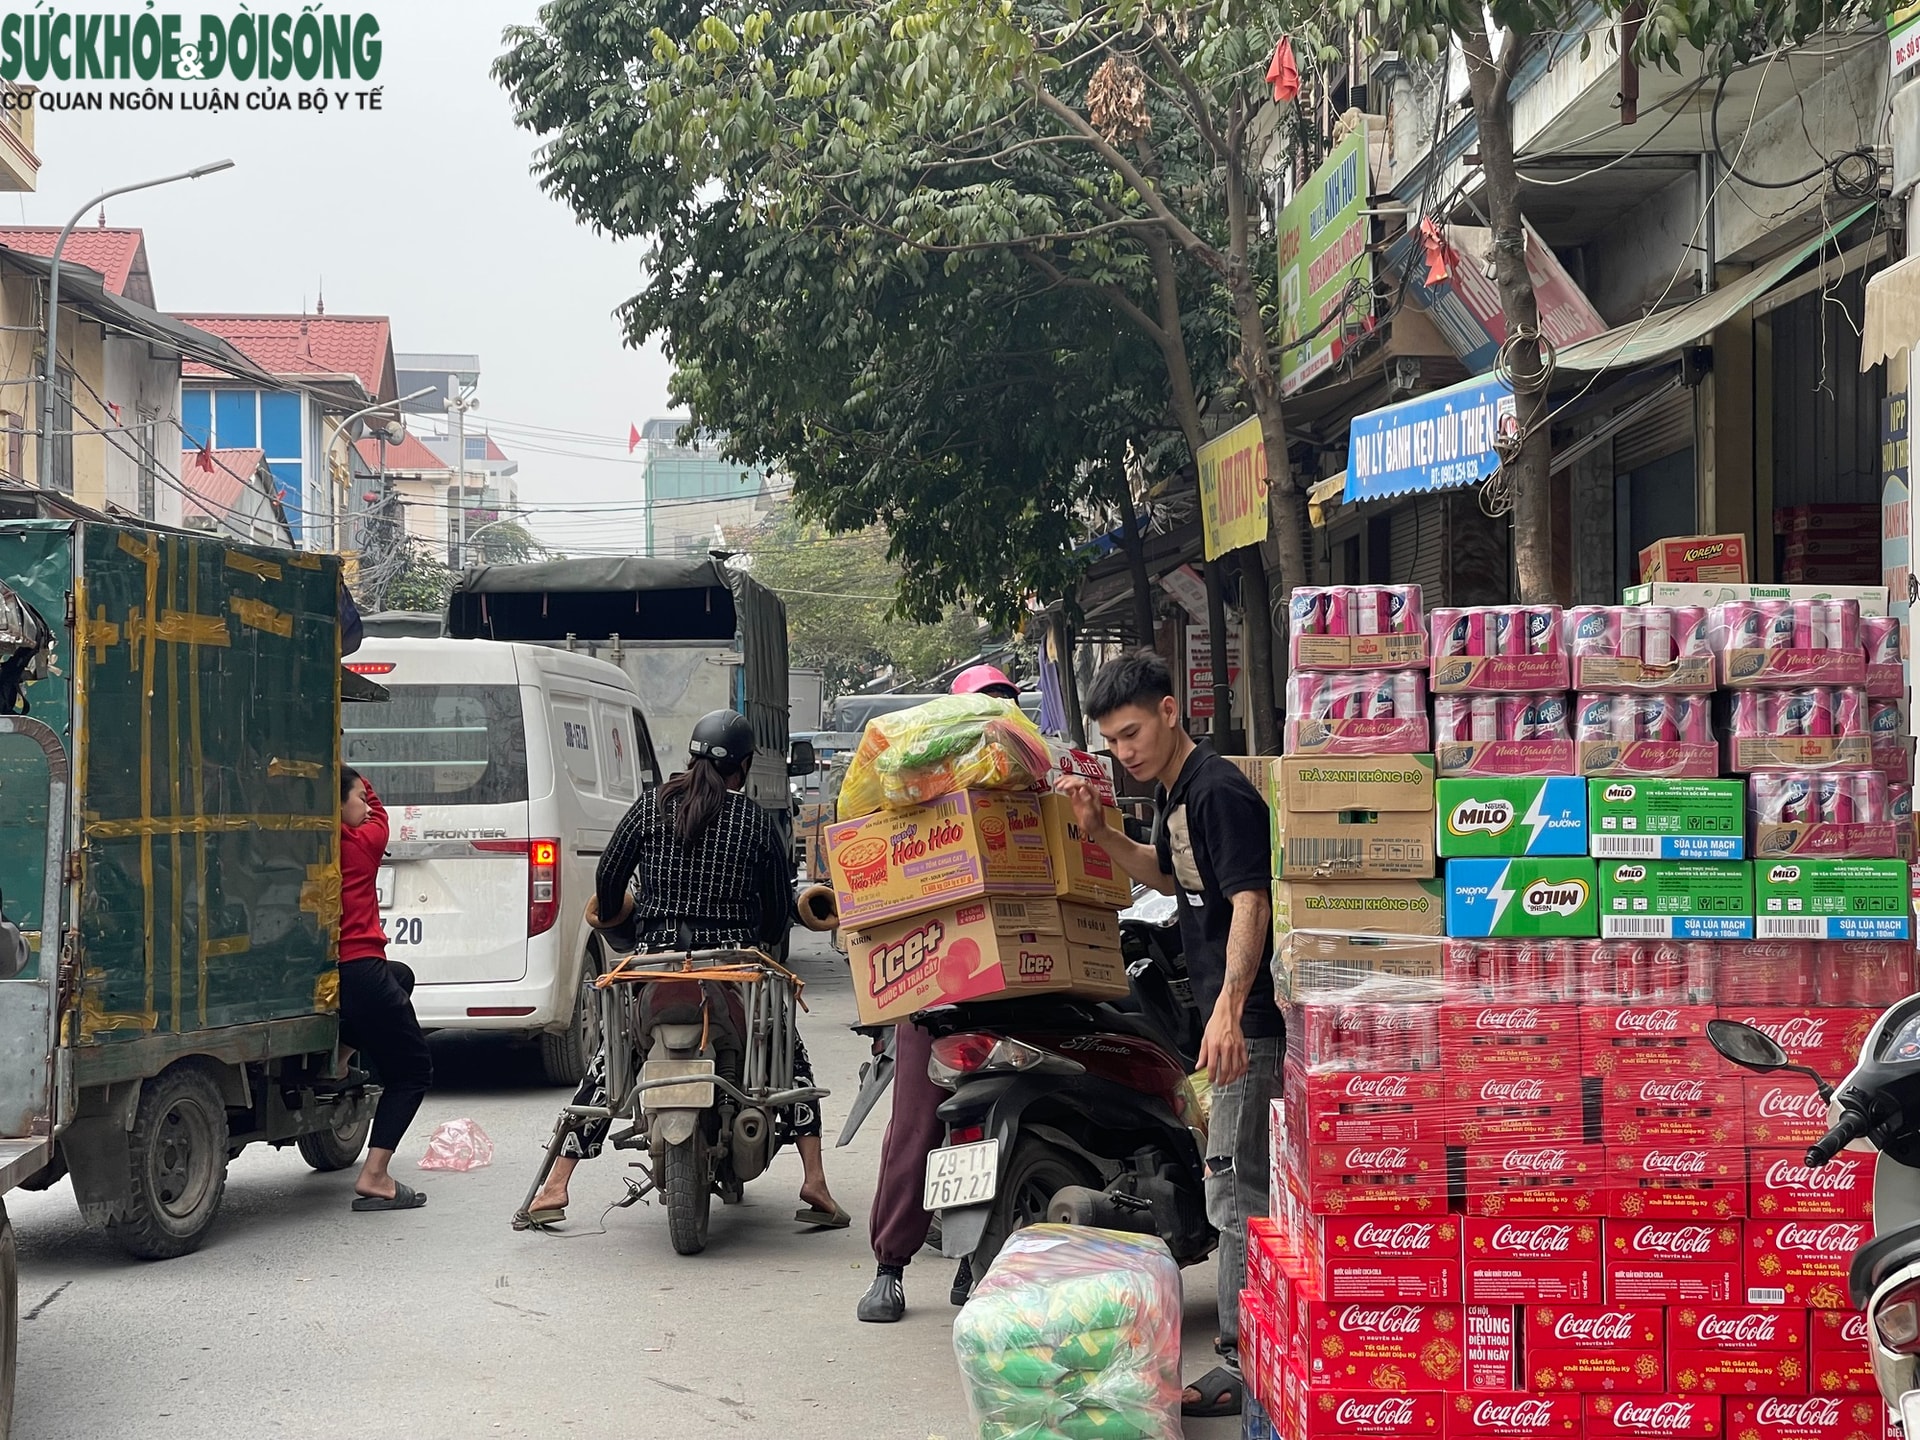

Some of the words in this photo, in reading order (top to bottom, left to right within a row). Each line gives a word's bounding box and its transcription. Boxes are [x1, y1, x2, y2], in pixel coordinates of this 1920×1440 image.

[1341, 150, 1358, 206] HUY
[1890, 399, 1906, 432] NPP
[1355, 434, 1370, 486] ĐẠI
[1371, 419, 1384, 475] LÝ
[1385, 415, 1411, 473] BÁNH
[1413, 417, 1435, 475] KẸO
[1437, 402, 1459, 462] HỮU
[1461, 392, 1495, 463] THIỆN
[1750, 587, 1791, 598] Vinamilk
[1299, 768, 1320, 782] TRÀ
[1323, 770, 1357, 783] XANH
[1358, 768, 1402, 783] KHÔNG
[1403, 769, 1423, 784] ĐỘ
[1607, 788, 1633, 798] MILO
[1458, 808, 1507, 825] MILO
[423, 827, 508, 840] FRONTIER
[890, 823, 918, 846] Handy
[892, 836, 927, 866] Hảo
[928, 819, 964, 851] Hảo
[1618, 869, 1644, 879] MILO
[1772, 869, 1798, 879] MILO
[1305, 896, 1327, 910] TRÀ
[1329, 898, 1363, 911] XANH
[1364, 896, 1408, 911] KHÔNG
[1410, 898, 1430, 912] ĐỘ
[1530, 889, 1579, 906] MILO
[850, 934, 873, 947] KIRIN
[871, 922, 943, 994] Ice+
[1020, 952, 1053, 974] Ice+
[1476, 1008, 1542, 1030] Coca-Cola
[1615, 1009, 1681, 1031] Coca-Cola
[1346, 1075, 1411, 1097] Coca-Cola
[1480, 1078, 1547, 1101] Coca-Cola
[1640, 1079, 1706, 1102] Coca-Cola
[937, 1145, 987, 1178] 29-T1
[1345, 1147, 1411, 1169] Coca-Cola
[1502, 1149, 1569, 1171] Coca-Cola
[1642, 1150, 1709, 1173] Coca-Cola
[931, 1171, 992, 1207] 767.27
[1353, 1222, 1436, 1250] Coca-Cola
[1491, 1223, 1574, 1252] Coca-Cola
[1632, 1225, 1716, 1253] Coca-Cola
[1775, 1222, 1865, 1252] Coca-Cola
[1339, 1304, 1424, 1334] Coca-Cola
[1468, 1306, 1477, 1315] CƠ
[1477, 1305, 1489, 1317] HỘI
[1468, 1315, 1510, 1334] TRÚNG
[1554, 1313, 1637, 1340] Coca-Cola
[1697, 1313, 1780, 1341] Coca-Cola
[1468, 1333, 1486, 1347] ĐIỆN
[1487, 1335, 1509, 1347] THOẠI
[1487, 1347, 1510, 1361] NGÀY
[1335, 1397, 1418, 1425] Coca-Cola
[1473, 1399, 1556, 1428] Coca-Cola
[1613, 1401, 1696, 1430] Coca-Cola
[1756, 1397, 1845, 1427] Coca-Cola
